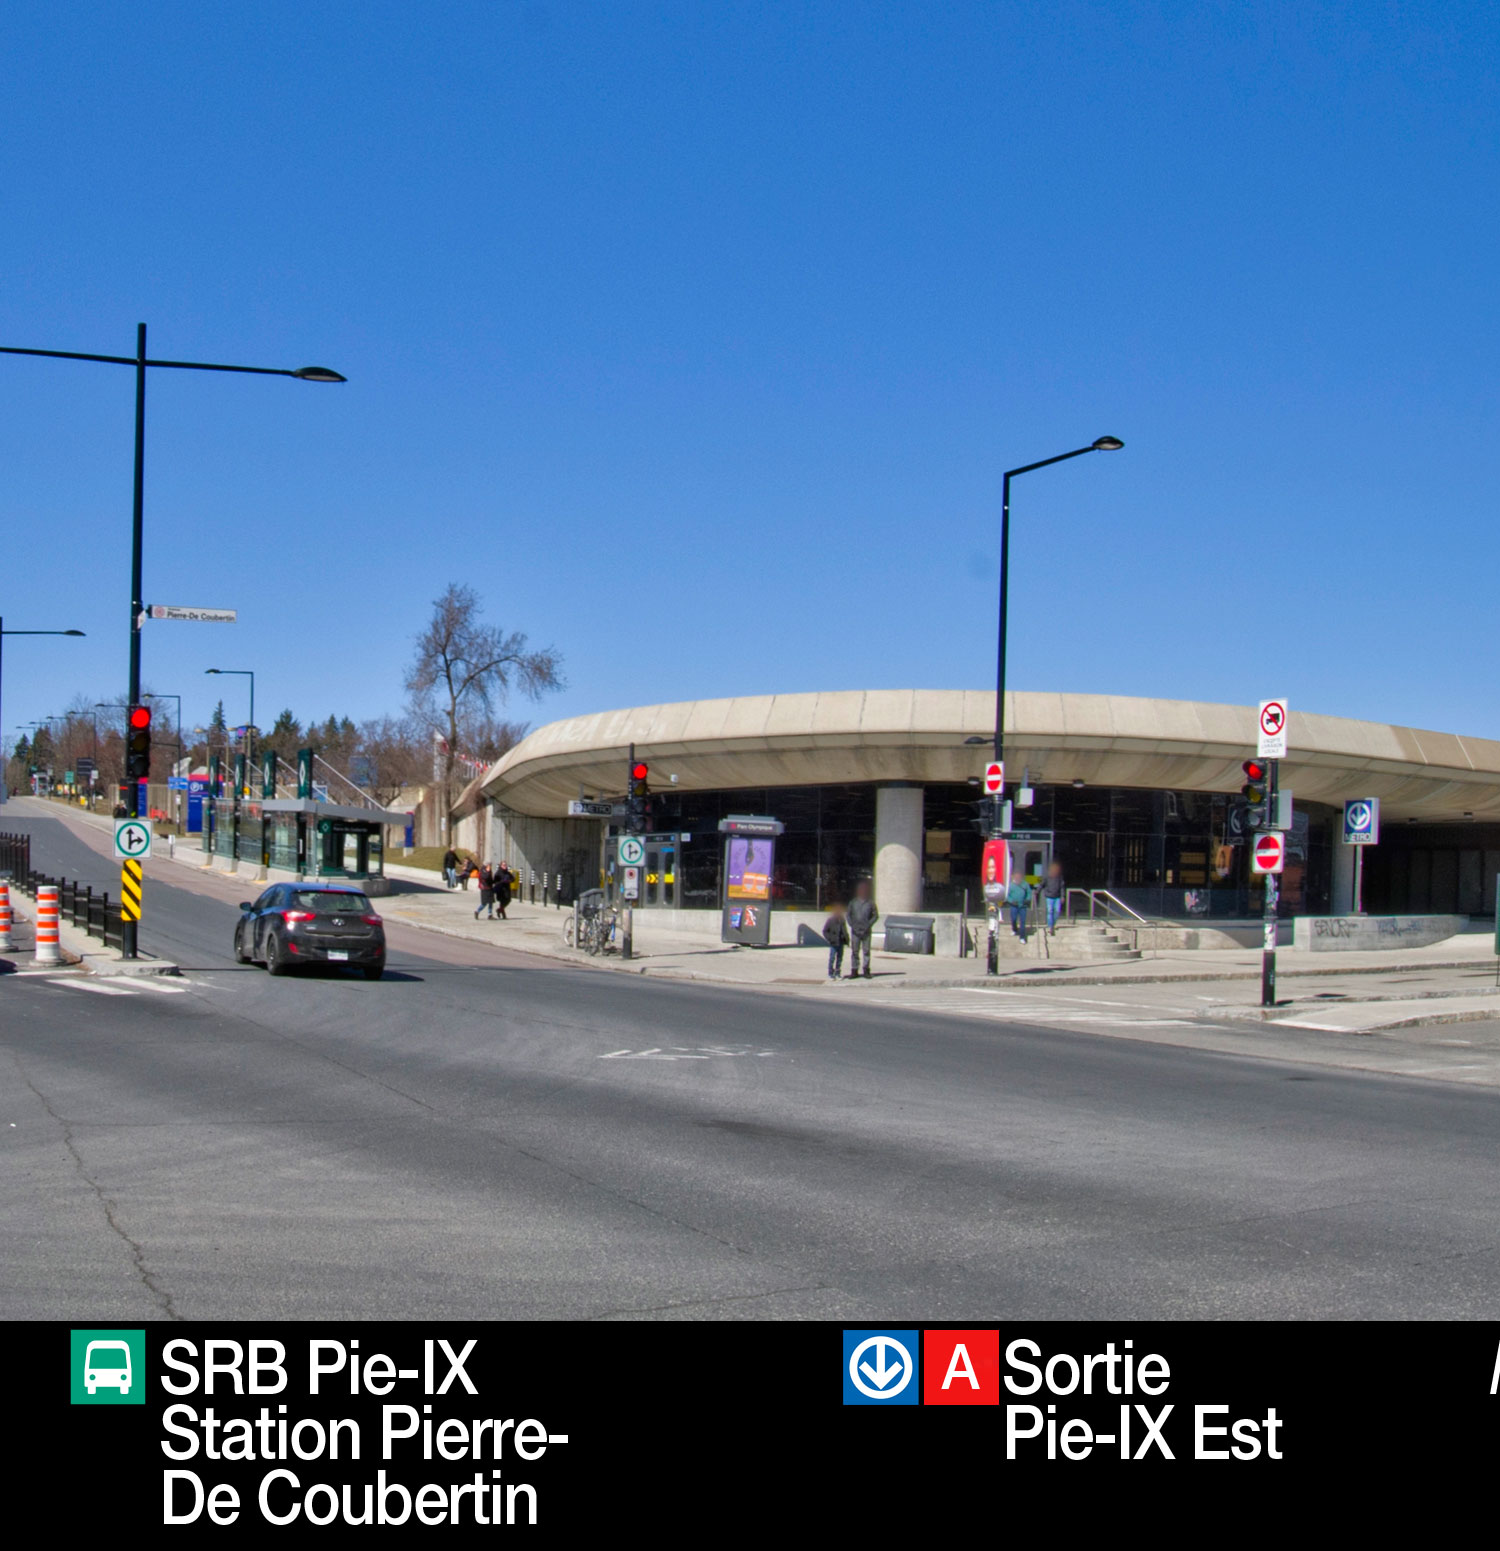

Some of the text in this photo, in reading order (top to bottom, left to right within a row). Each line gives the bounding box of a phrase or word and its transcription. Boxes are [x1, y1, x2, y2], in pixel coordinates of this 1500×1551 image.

[167, 611, 235, 622] Pierre-De Coubertin
[586, 803, 611, 814] METRO
[1344, 832, 1371, 842] METRO
